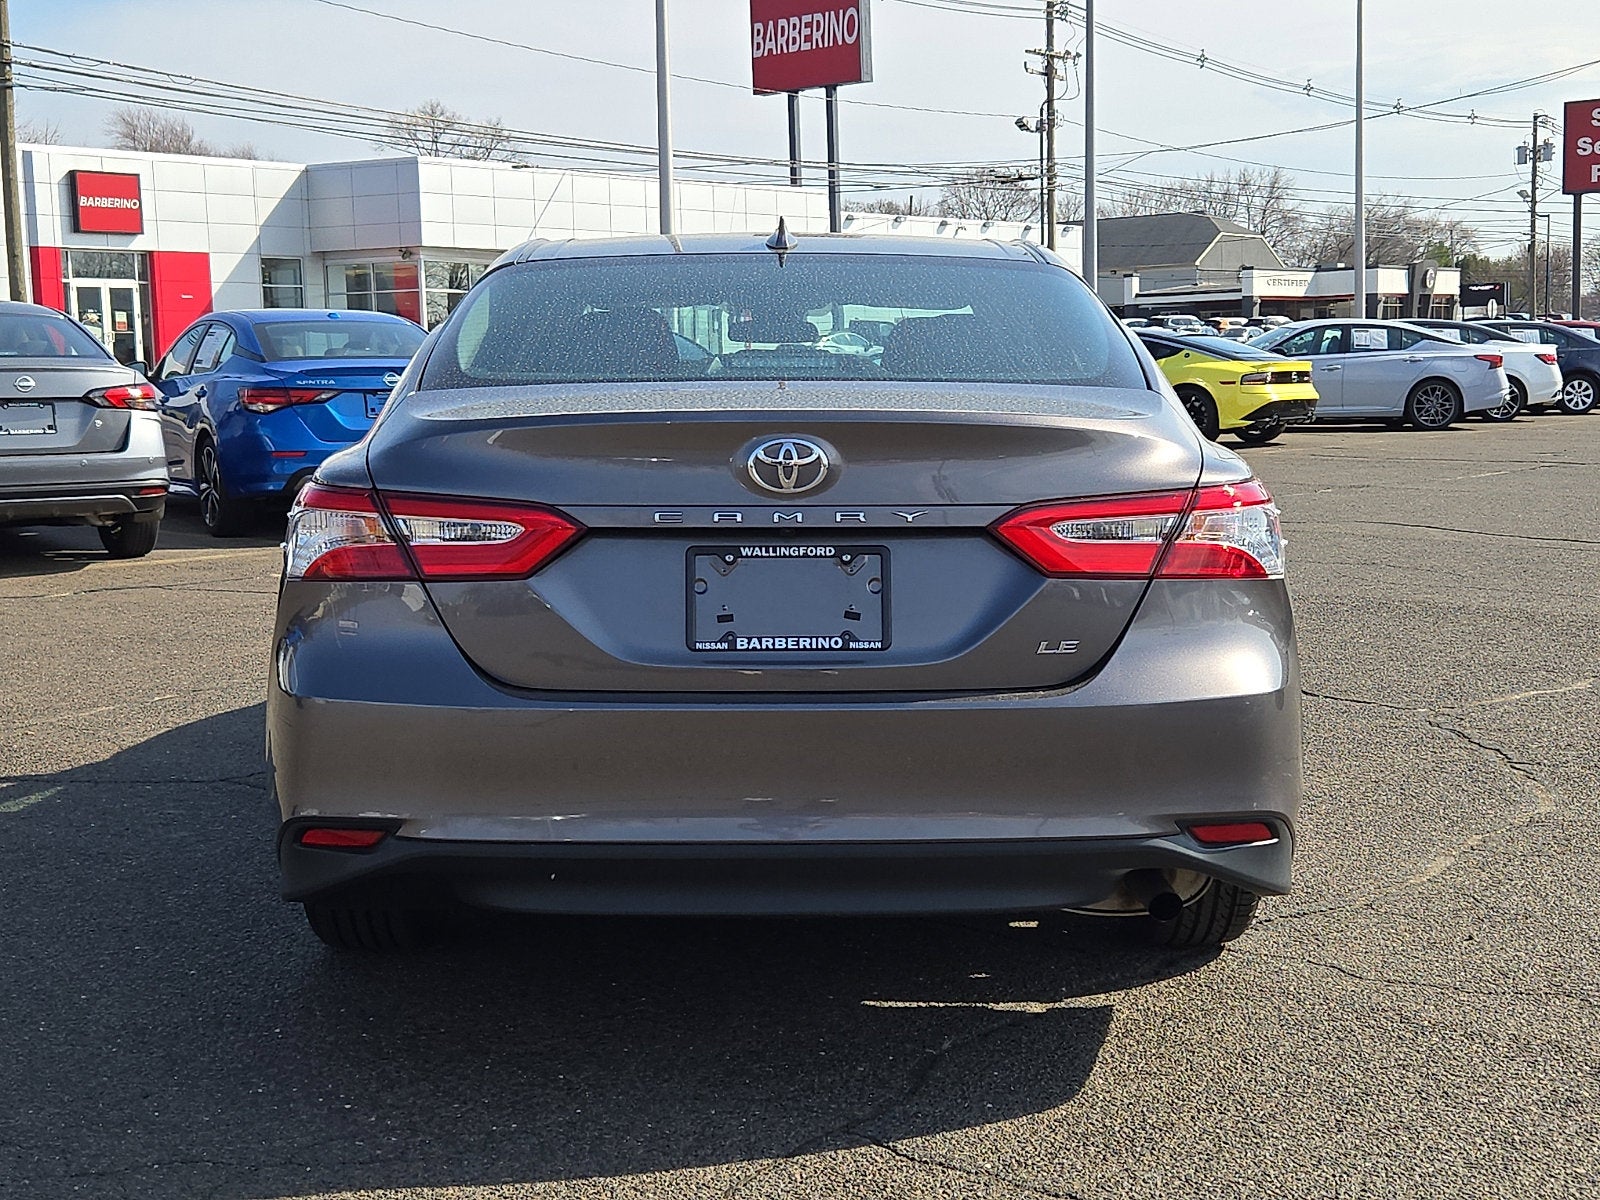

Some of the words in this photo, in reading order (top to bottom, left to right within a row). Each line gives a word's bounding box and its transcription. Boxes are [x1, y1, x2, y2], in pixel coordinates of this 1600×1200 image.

[753, 7, 859, 58] BARBERINO
[80, 195, 140, 209] BARBERINO
[1266, 278, 1310, 287] CERTIFIED
[654, 510, 929, 523] CAMRY
[740, 546, 836, 557] WALLINGFORD
[695, 641, 728, 650] NISSAN
[736, 637, 843, 650] BARBERINO
[849, 641, 882, 649] NISSAN
[1036, 640, 1081, 654] LE
